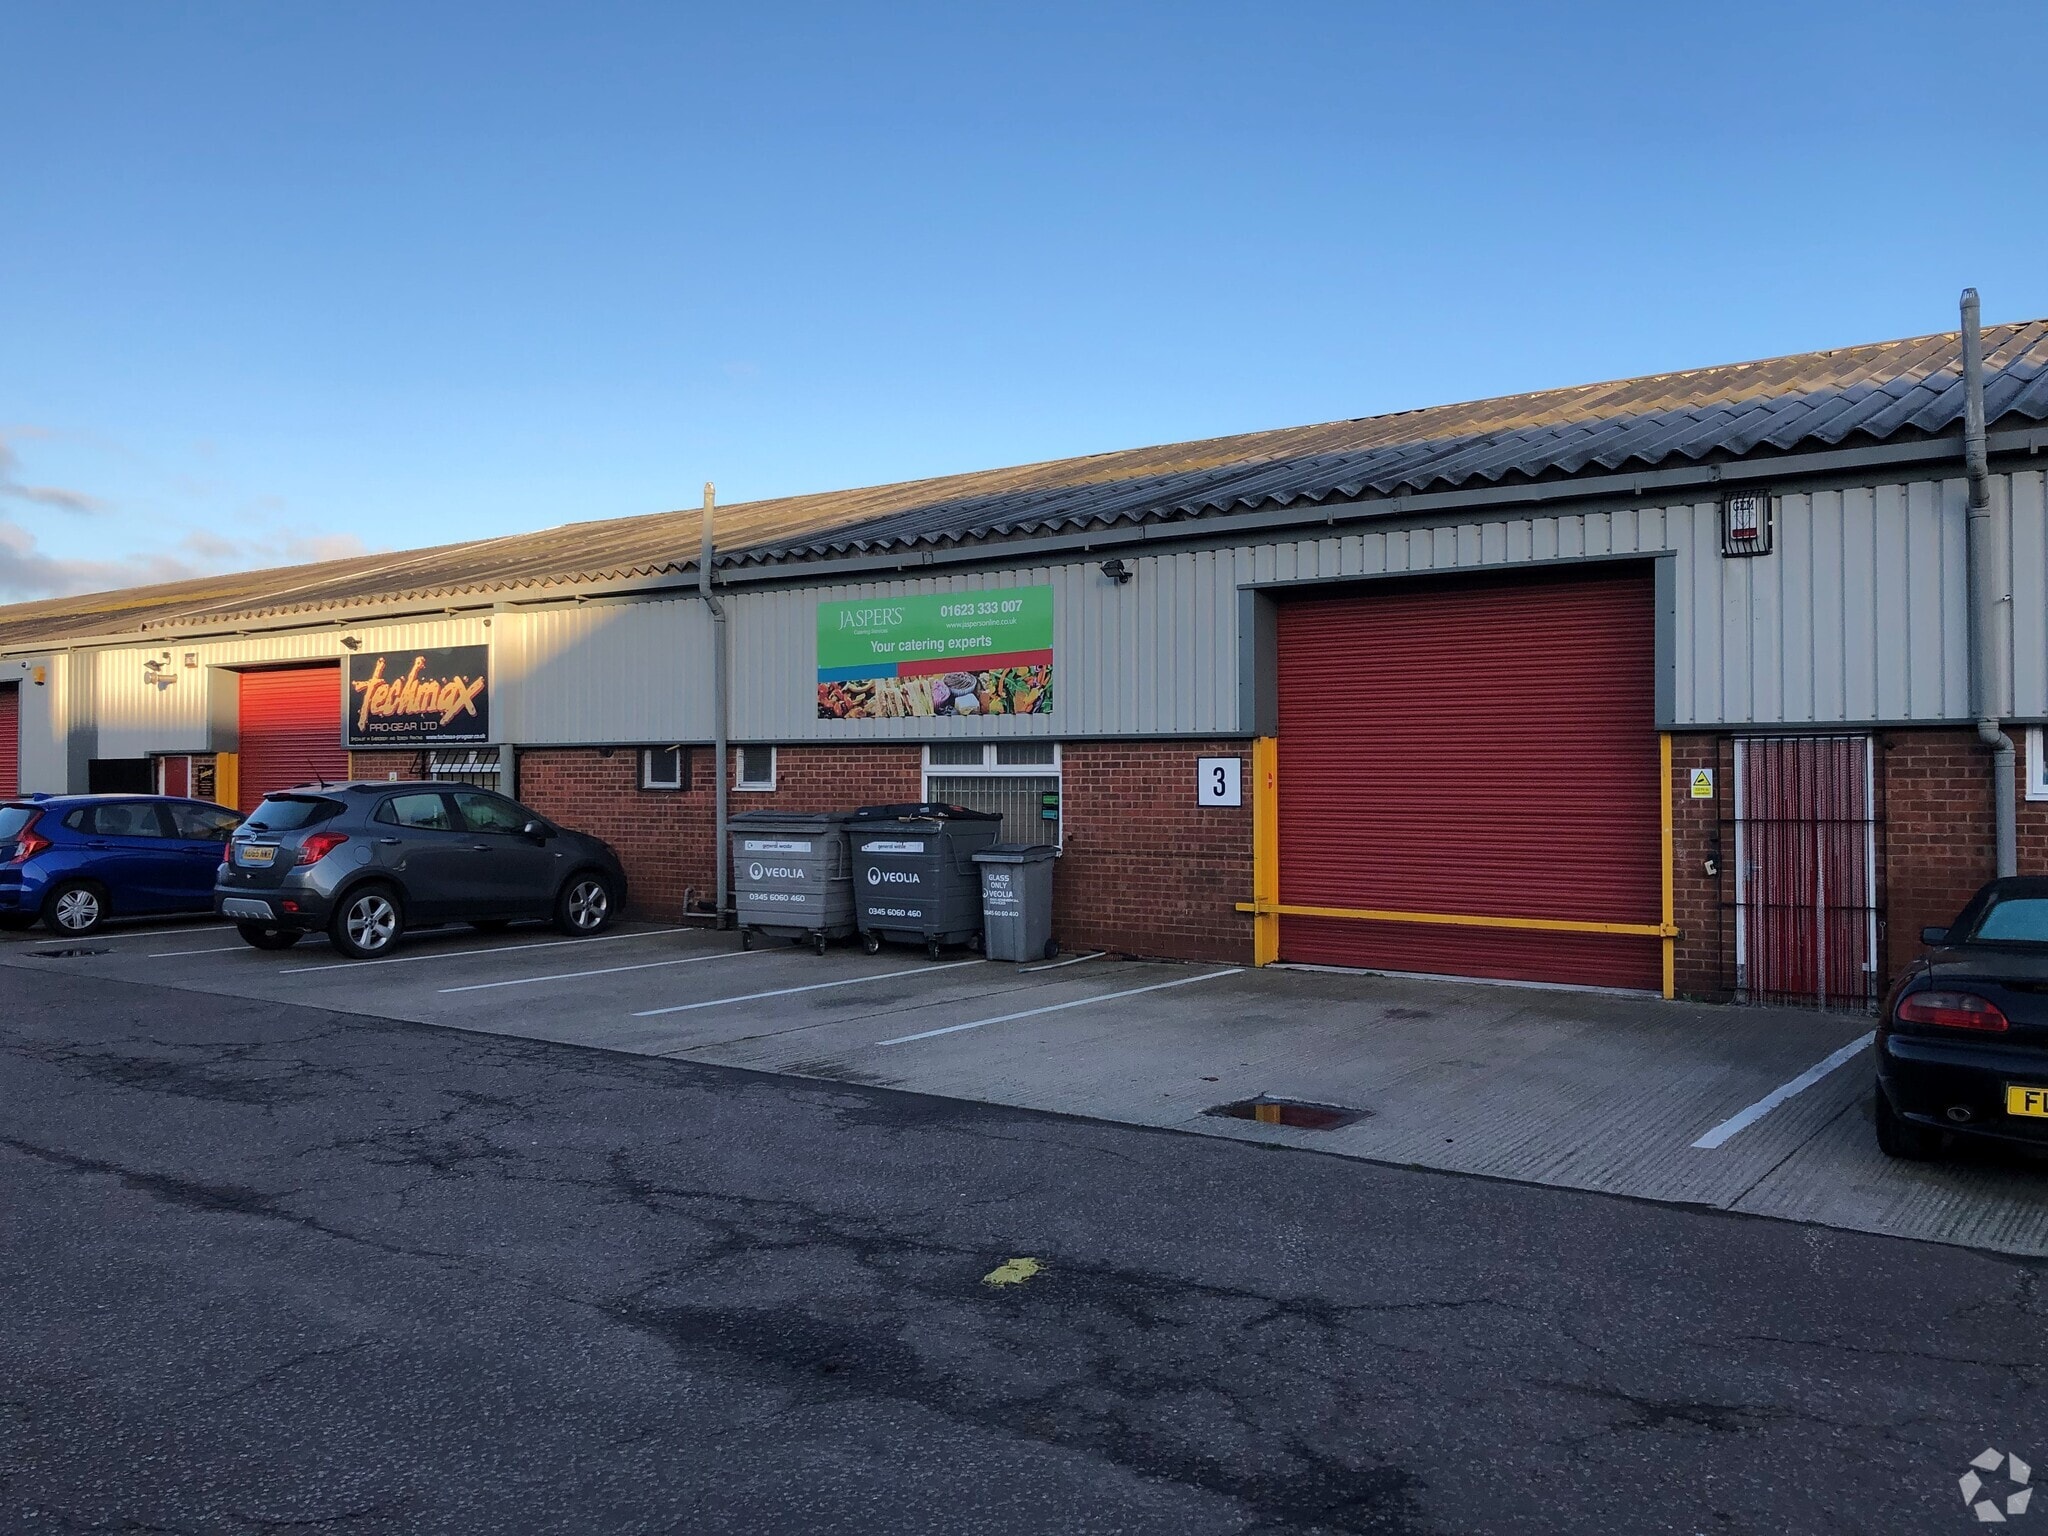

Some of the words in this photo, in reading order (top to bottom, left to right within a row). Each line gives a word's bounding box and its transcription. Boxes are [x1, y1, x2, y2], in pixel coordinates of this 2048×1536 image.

[940, 605, 975, 617] 01623
[977, 602, 998, 615] 333
[1001, 600, 1023, 613] 007
[838, 607, 903, 631] JASPER'S
[870, 640, 896, 653] Your
[898, 638, 945, 652] catering
[948, 635, 992, 651] experts
[369, 722, 418, 732] PRO-GEAR
[420, 721, 438, 731] LTD
[1213, 766, 1226, 797] 3
[764, 867, 805, 879] VEOLIA
[881, 872, 921, 884] VEOLIA
[749, 893, 768, 901] 0345
[769, 893, 789, 901] 6060
[790, 894, 806, 902] 460
[868, 907, 886, 915] 0345
[887, 908, 906, 916] 6060
